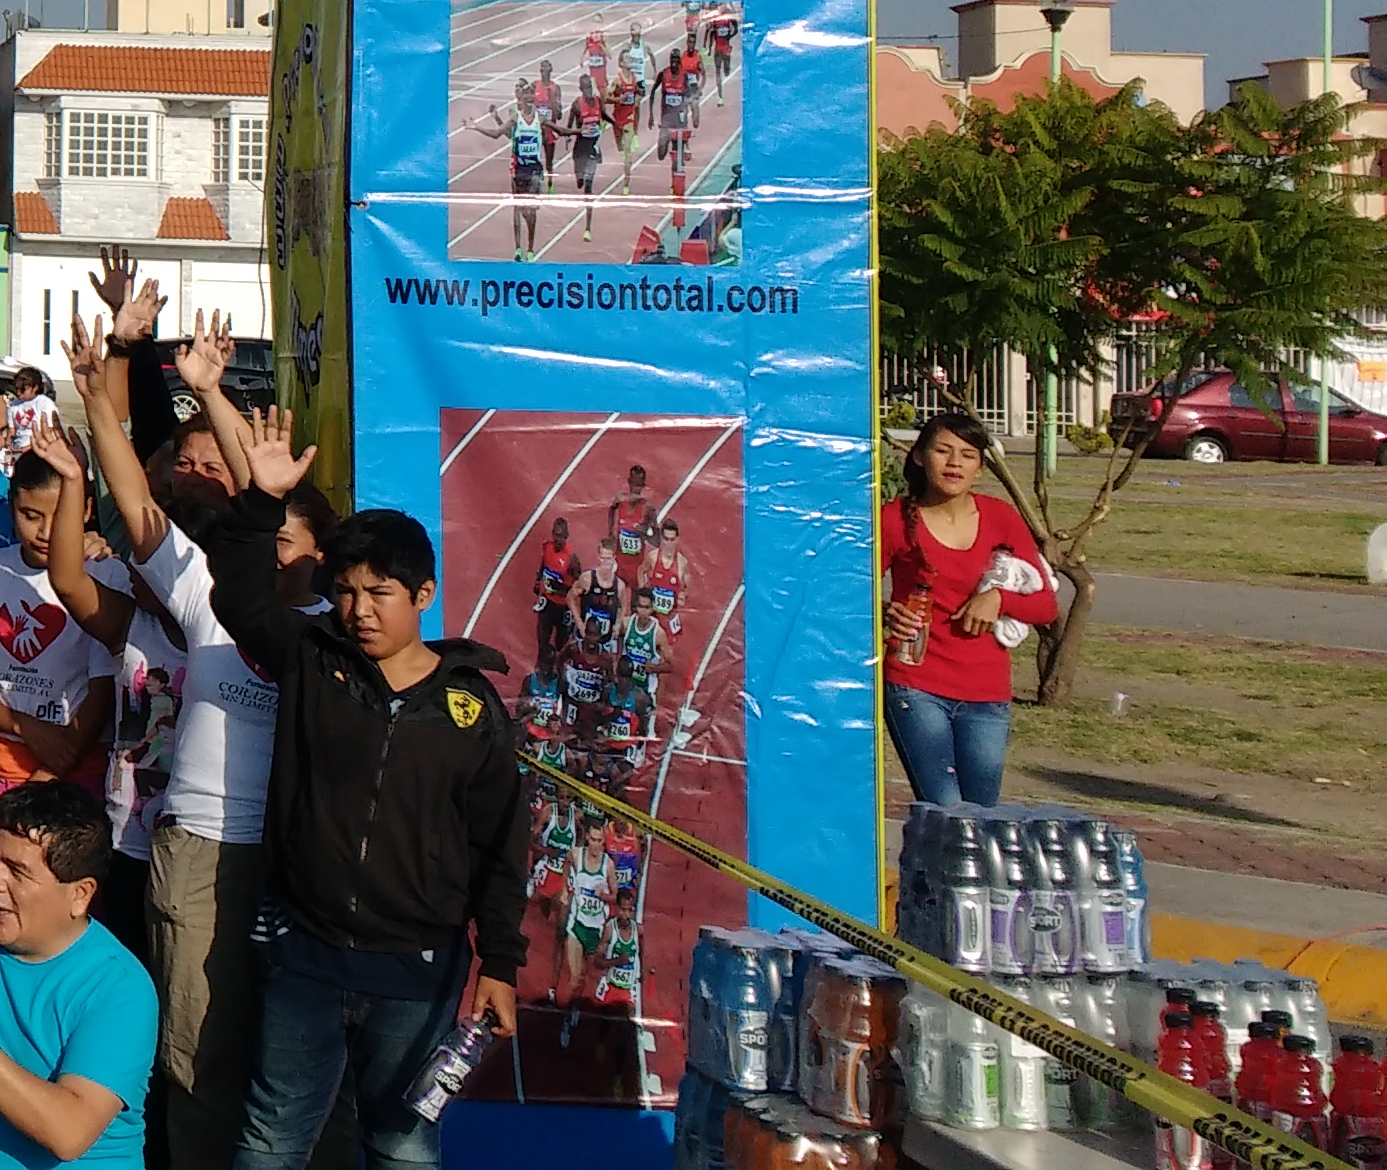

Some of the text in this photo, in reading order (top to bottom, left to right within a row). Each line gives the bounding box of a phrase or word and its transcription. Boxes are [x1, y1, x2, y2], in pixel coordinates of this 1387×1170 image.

[385, 272, 799, 317] www.precisiontotal.com
[218, 681, 280, 705] CORAZO
[739, 1032, 768, 1046] SPO
[434, 1070, 463, 1094] SPOR
